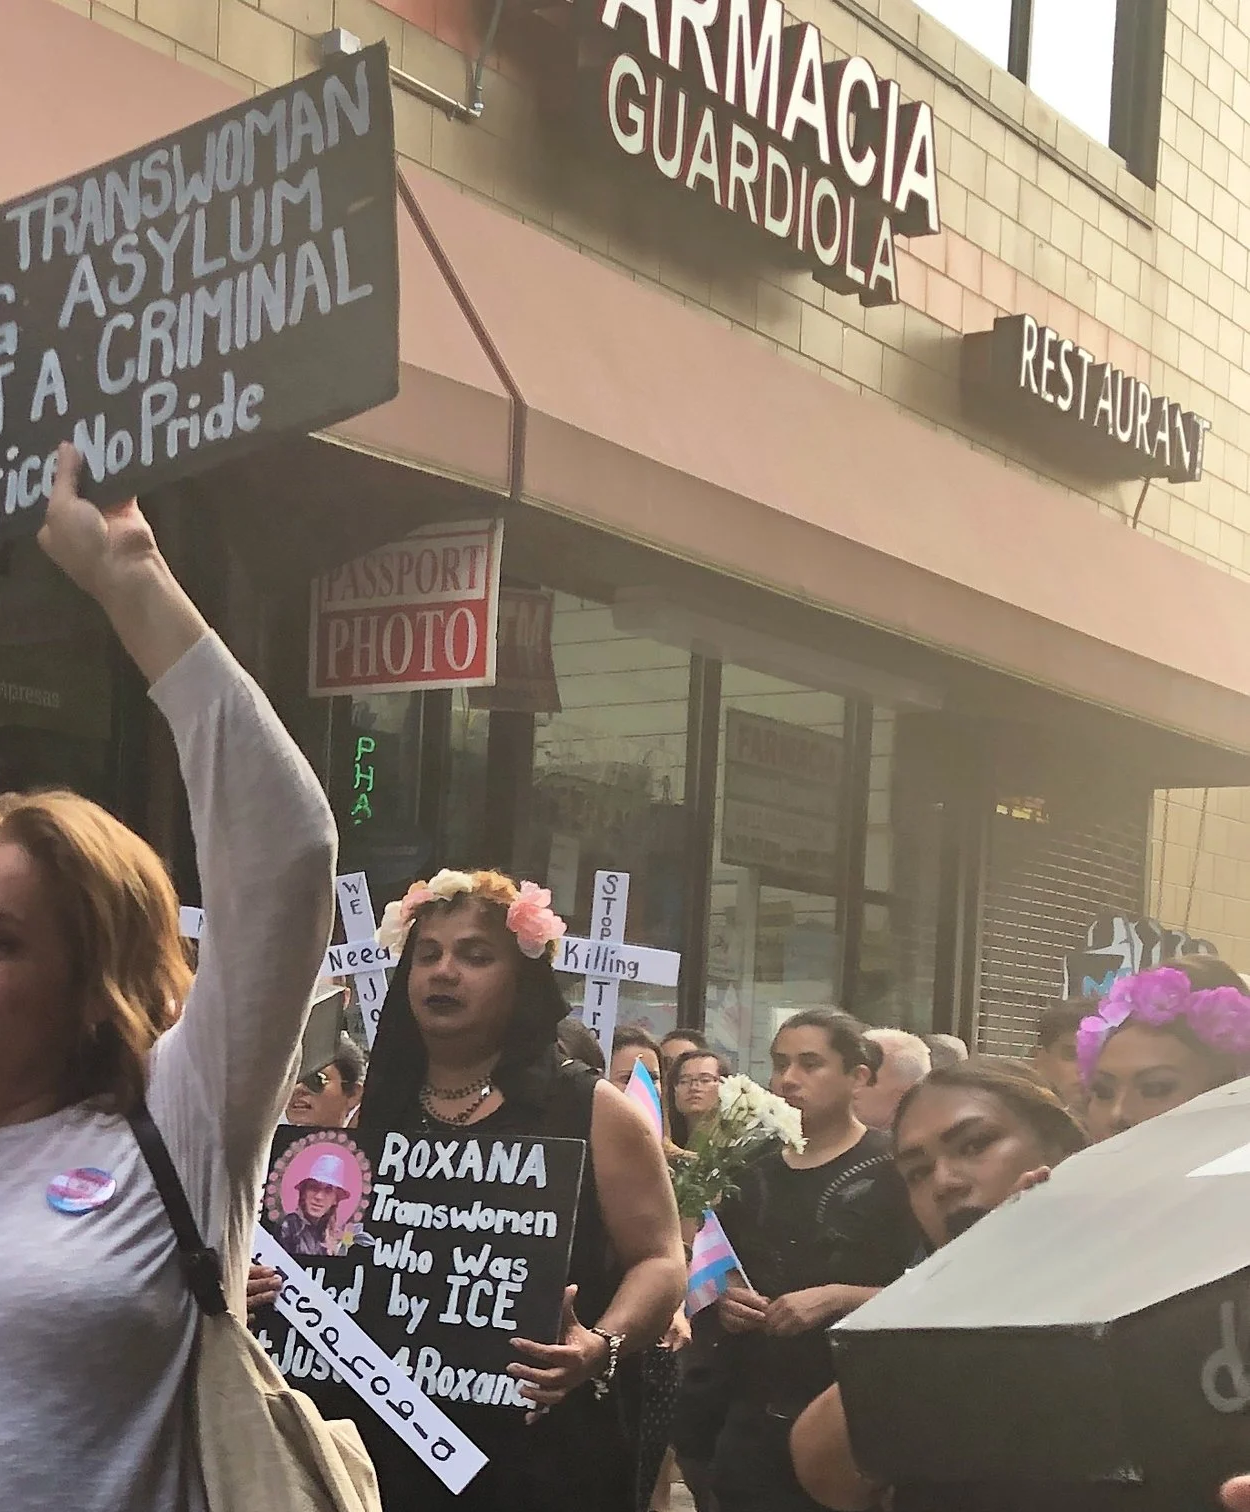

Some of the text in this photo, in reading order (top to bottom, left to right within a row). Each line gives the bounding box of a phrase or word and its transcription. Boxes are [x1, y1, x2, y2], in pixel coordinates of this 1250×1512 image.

[6, 61, 370, 272] TRANSWOMAN
[607, 54, 899, 302] GUARDIOLA
[59, 168, 322, 329] ASYLUM
[30, 349, 67, 422] A
[99, 228, 373, 395] CRIMINAL
[1020, 315, 1211, 481] RESTAURANT
[327, 544, 486, 604] PASSPORT
[326, 607, 478, 680] PHOTO
[564, 940, 639, 979] Killing
[378, 1132, 547, 1189] ROXANA
[371, 1184, 558, 1238] Transwomen
[387, 1274, 430, 1334] by
[439, 1274, 523, 1330] ICE
